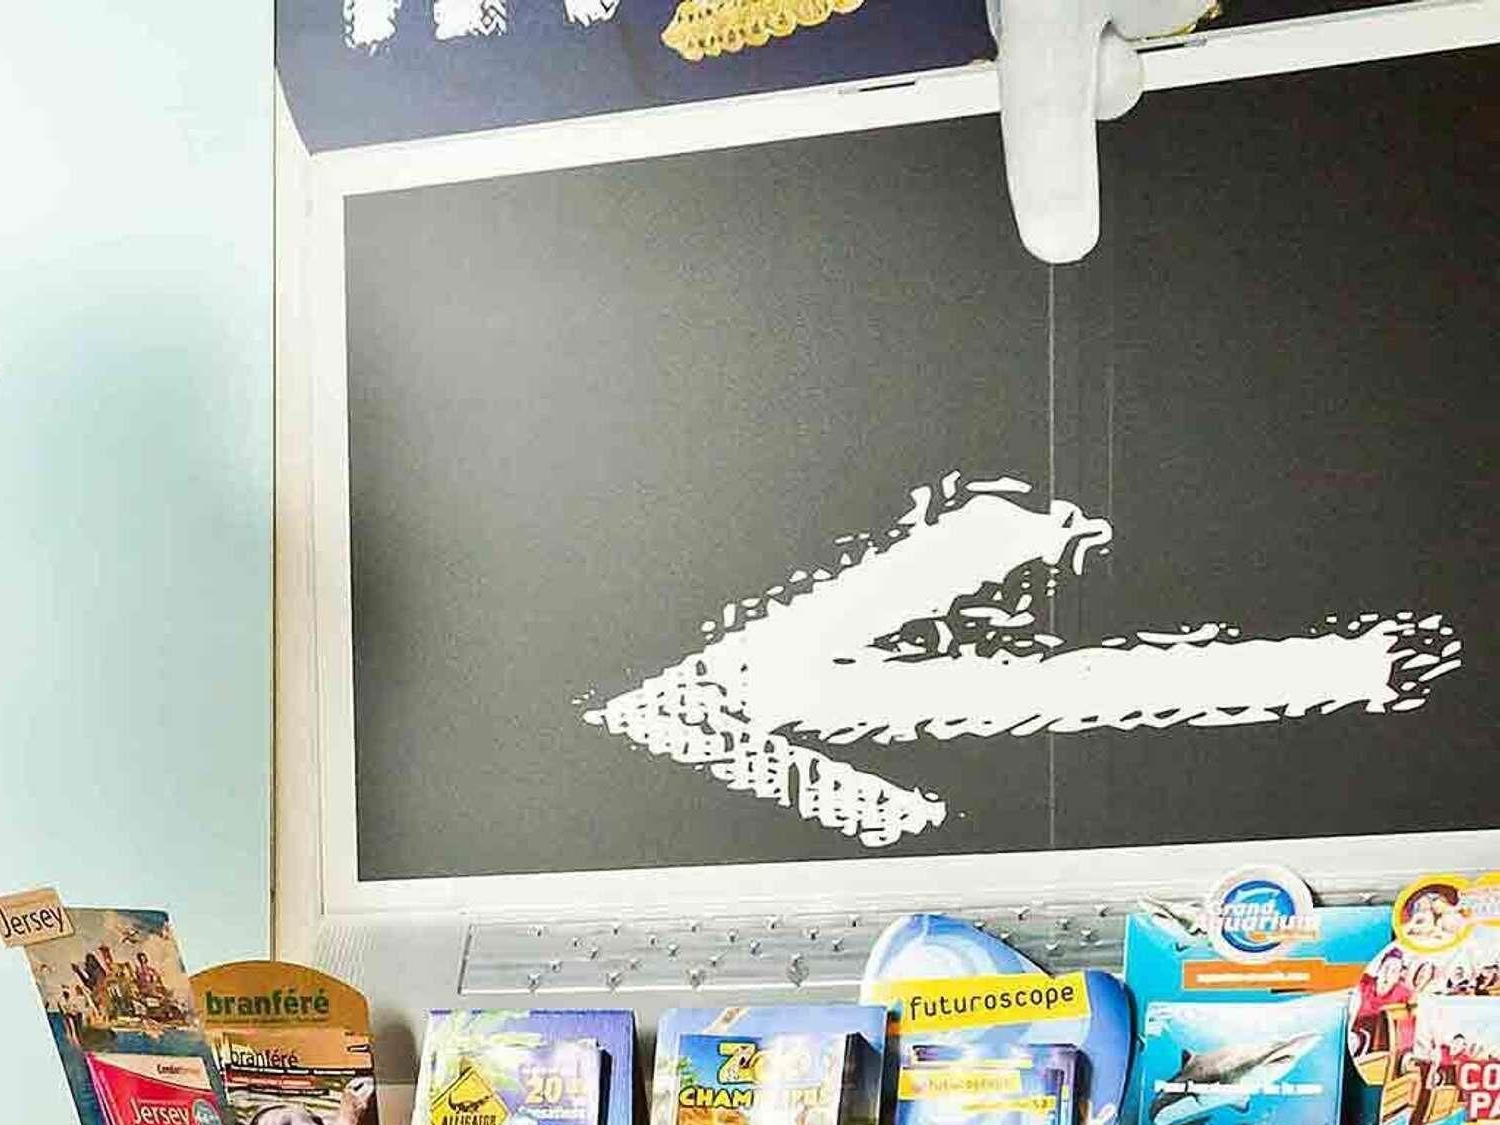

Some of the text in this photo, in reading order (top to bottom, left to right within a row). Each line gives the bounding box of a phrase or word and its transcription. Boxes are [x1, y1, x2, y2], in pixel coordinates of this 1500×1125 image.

[0, 907, 63, 938] Jersey
[206, 989, 329, 1015] branféré
[910, 986, 1074, 1021] futuroscope
